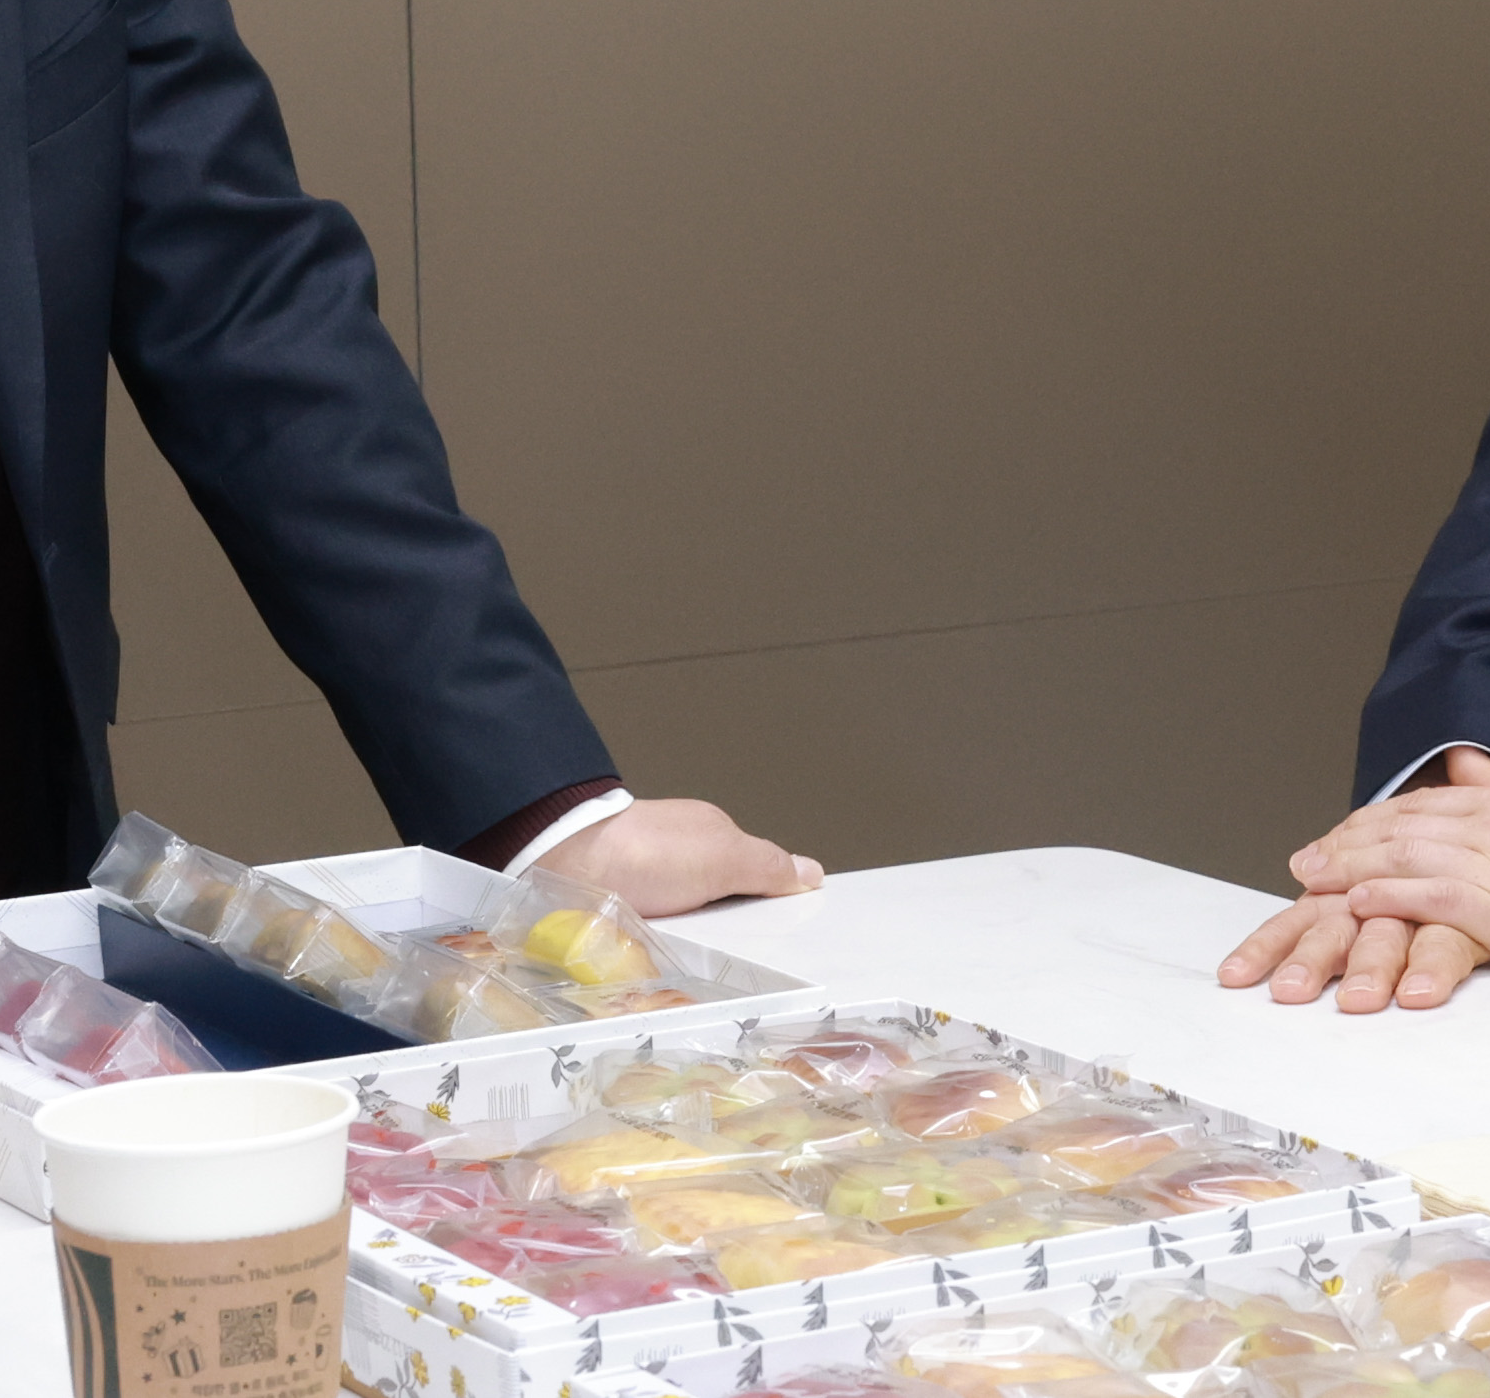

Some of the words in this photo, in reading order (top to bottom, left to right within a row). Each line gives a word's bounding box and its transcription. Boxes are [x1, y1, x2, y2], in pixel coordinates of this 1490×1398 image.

[143, 1274, 168, 1288] The
[171, 1274, 207, 1288] More
[248, 1268, 272, 1282] The
